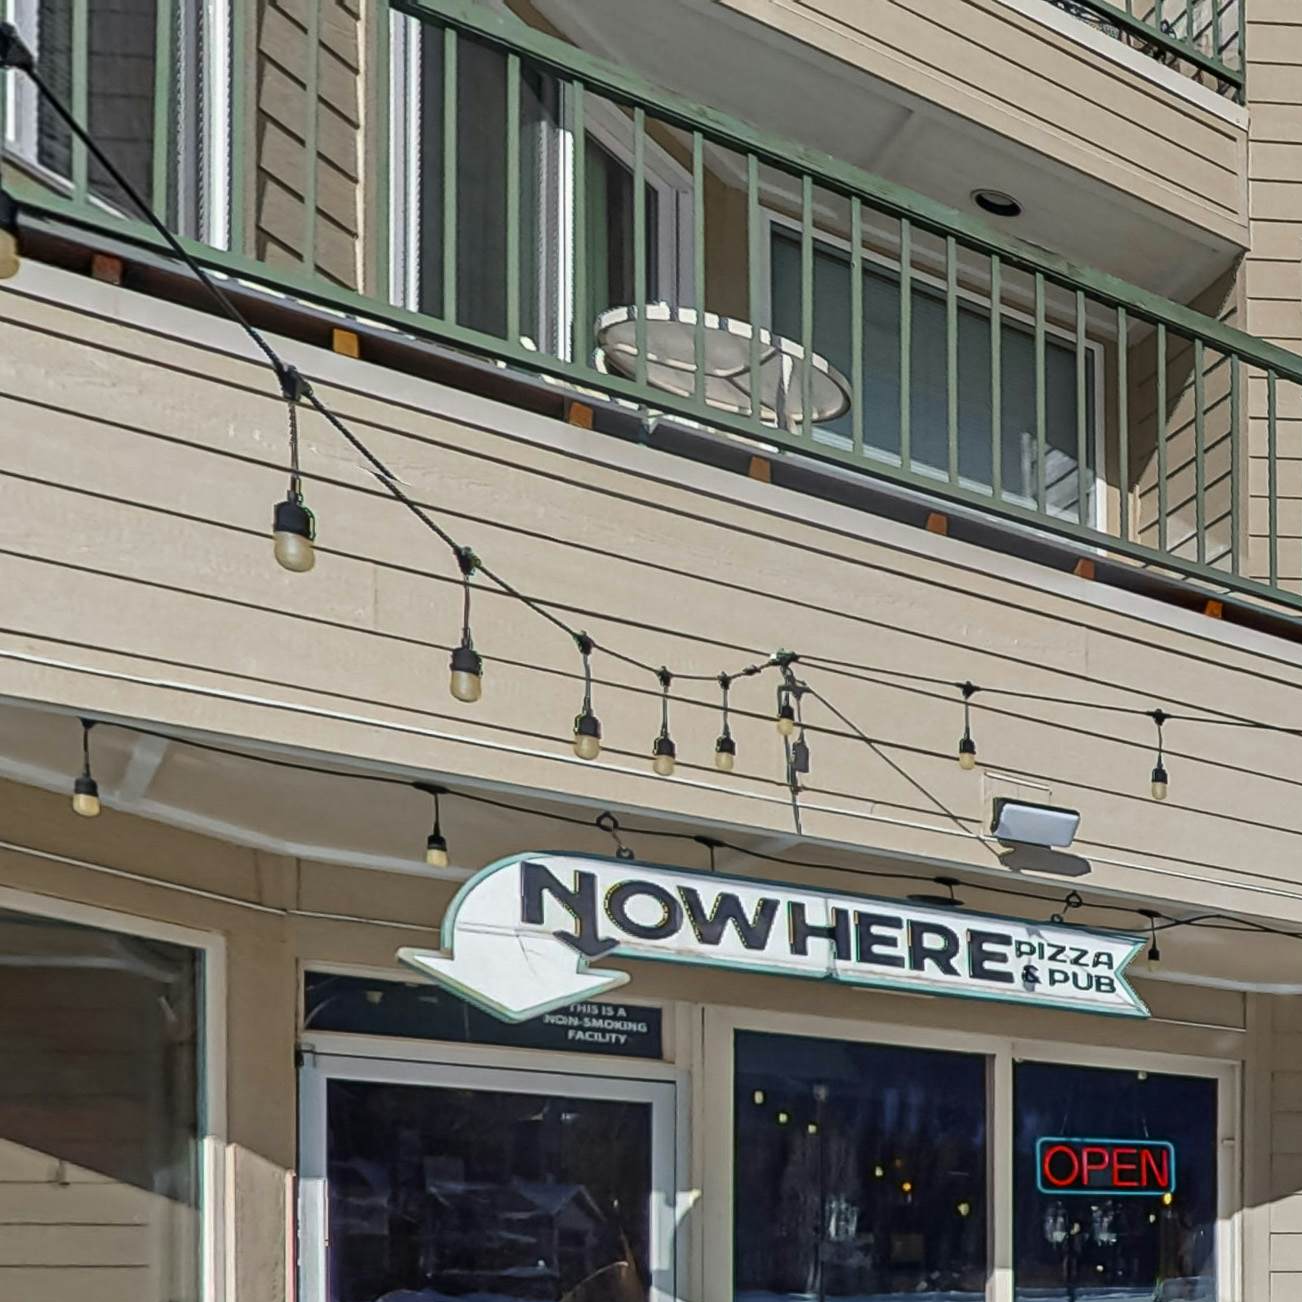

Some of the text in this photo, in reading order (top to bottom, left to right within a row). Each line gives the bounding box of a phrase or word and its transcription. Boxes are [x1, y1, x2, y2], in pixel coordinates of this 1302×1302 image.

[521, 861, 1013, 983] NOWHERE
[1015, 940, 1114, 970] PIZZA
[1022, 965, 1117, 993] & PUB
[543, 1014, 648, 1033] NON-SMOKING
[570, 1003, 627, 1017] THIS IS A
[567, 1029, 628, 1044] FACILITY
[1043, 1145, 1169, 1187] OPEN
